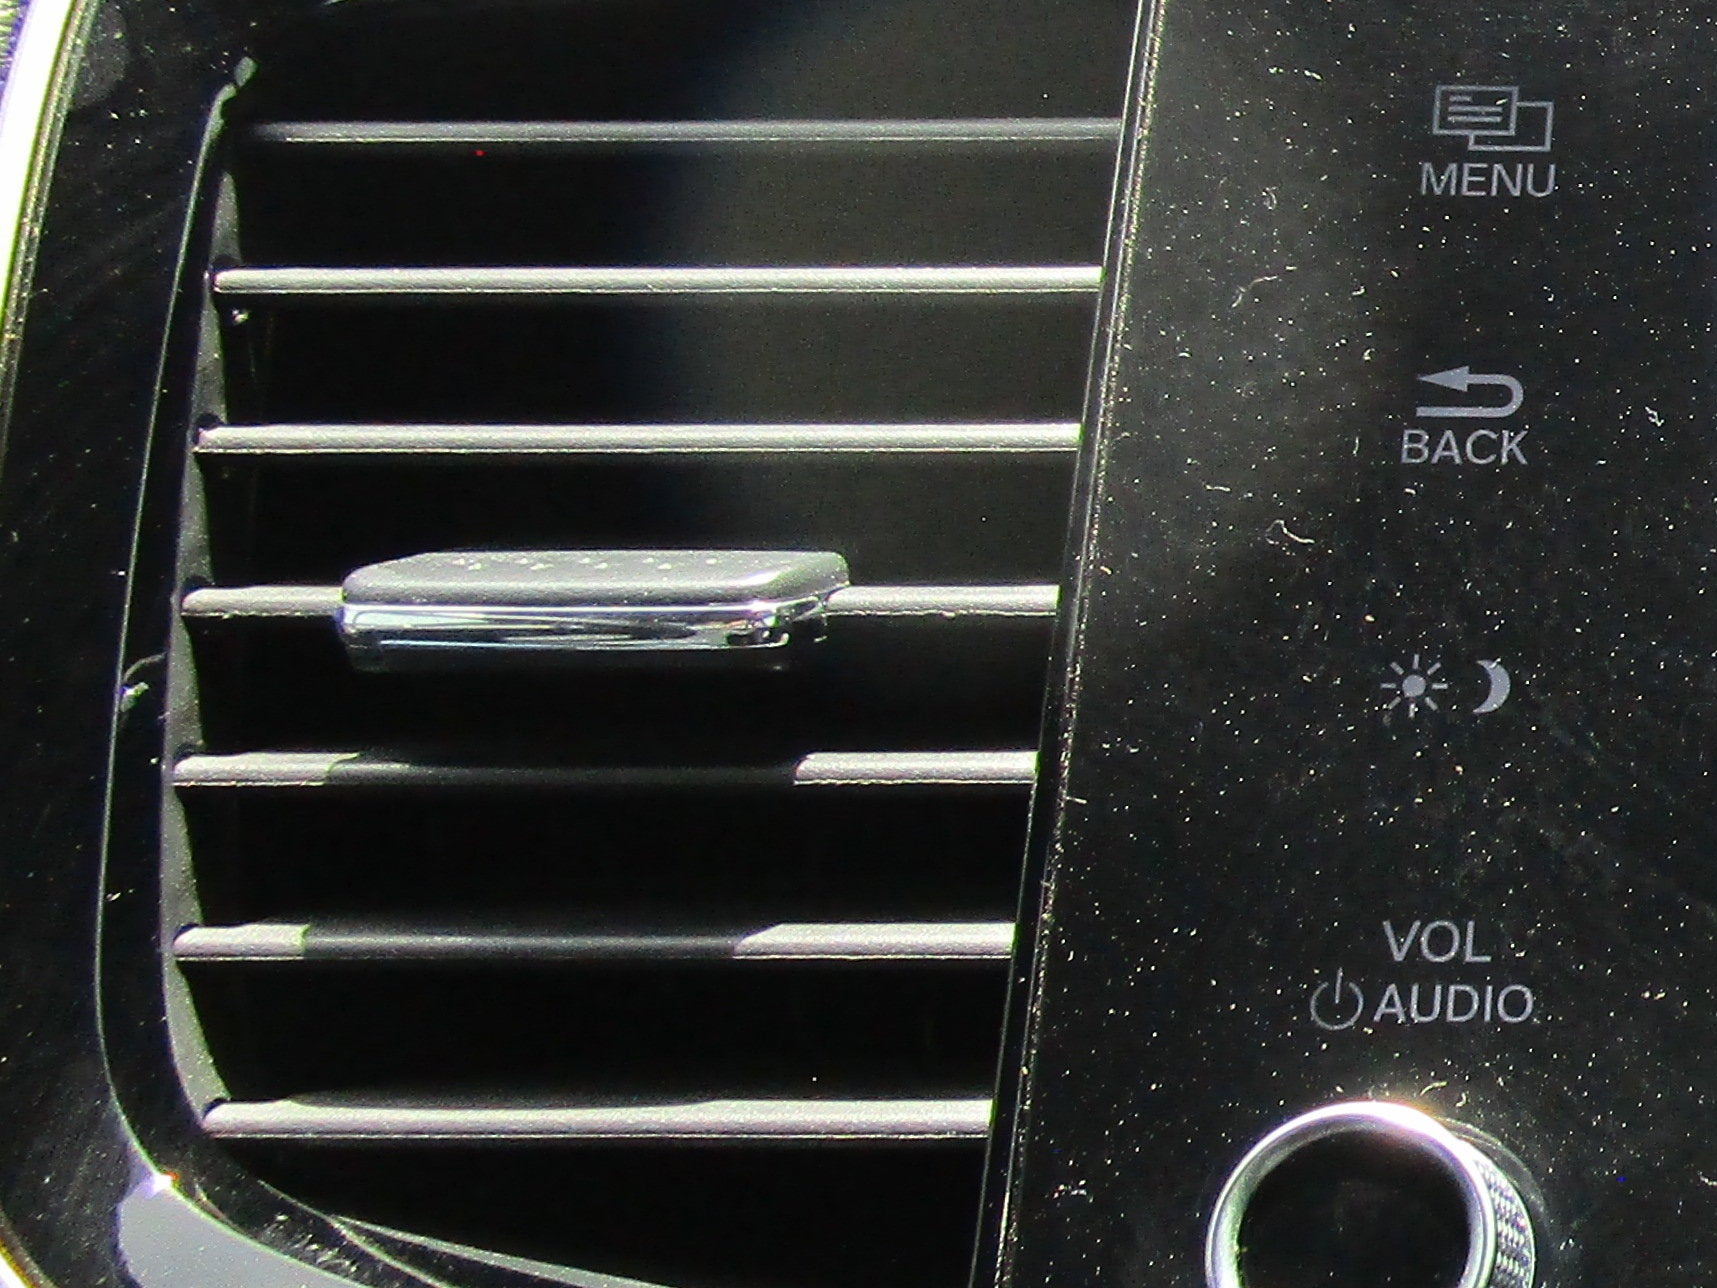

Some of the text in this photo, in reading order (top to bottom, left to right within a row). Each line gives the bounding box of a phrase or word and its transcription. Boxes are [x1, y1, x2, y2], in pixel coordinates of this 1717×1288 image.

[1419, 160, 1557, 198] MENU
[1400, 428, 1530, 466] BACK
[1382, 918, 1493, 964] VOL
[1371, 982, 1536, 1026] AUDIO
